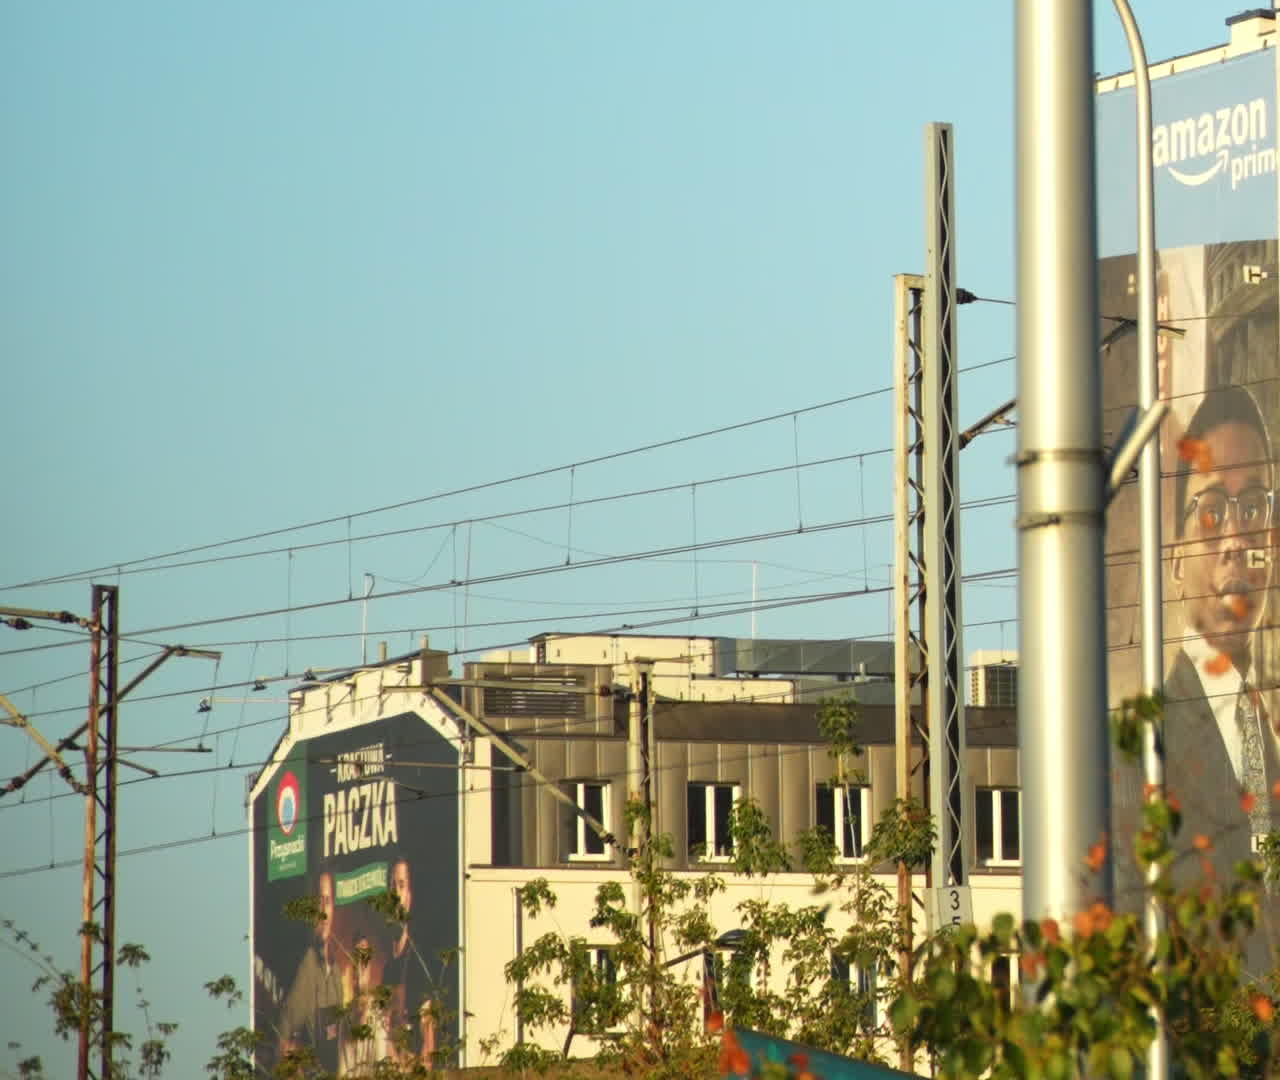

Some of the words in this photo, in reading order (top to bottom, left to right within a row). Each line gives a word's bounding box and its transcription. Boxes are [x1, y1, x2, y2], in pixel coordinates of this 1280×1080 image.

[1152, 99, 1267, 168] amazon
[1230, 147, 1279, 191] prim
[323, 781, 398, 857] PACZKA
